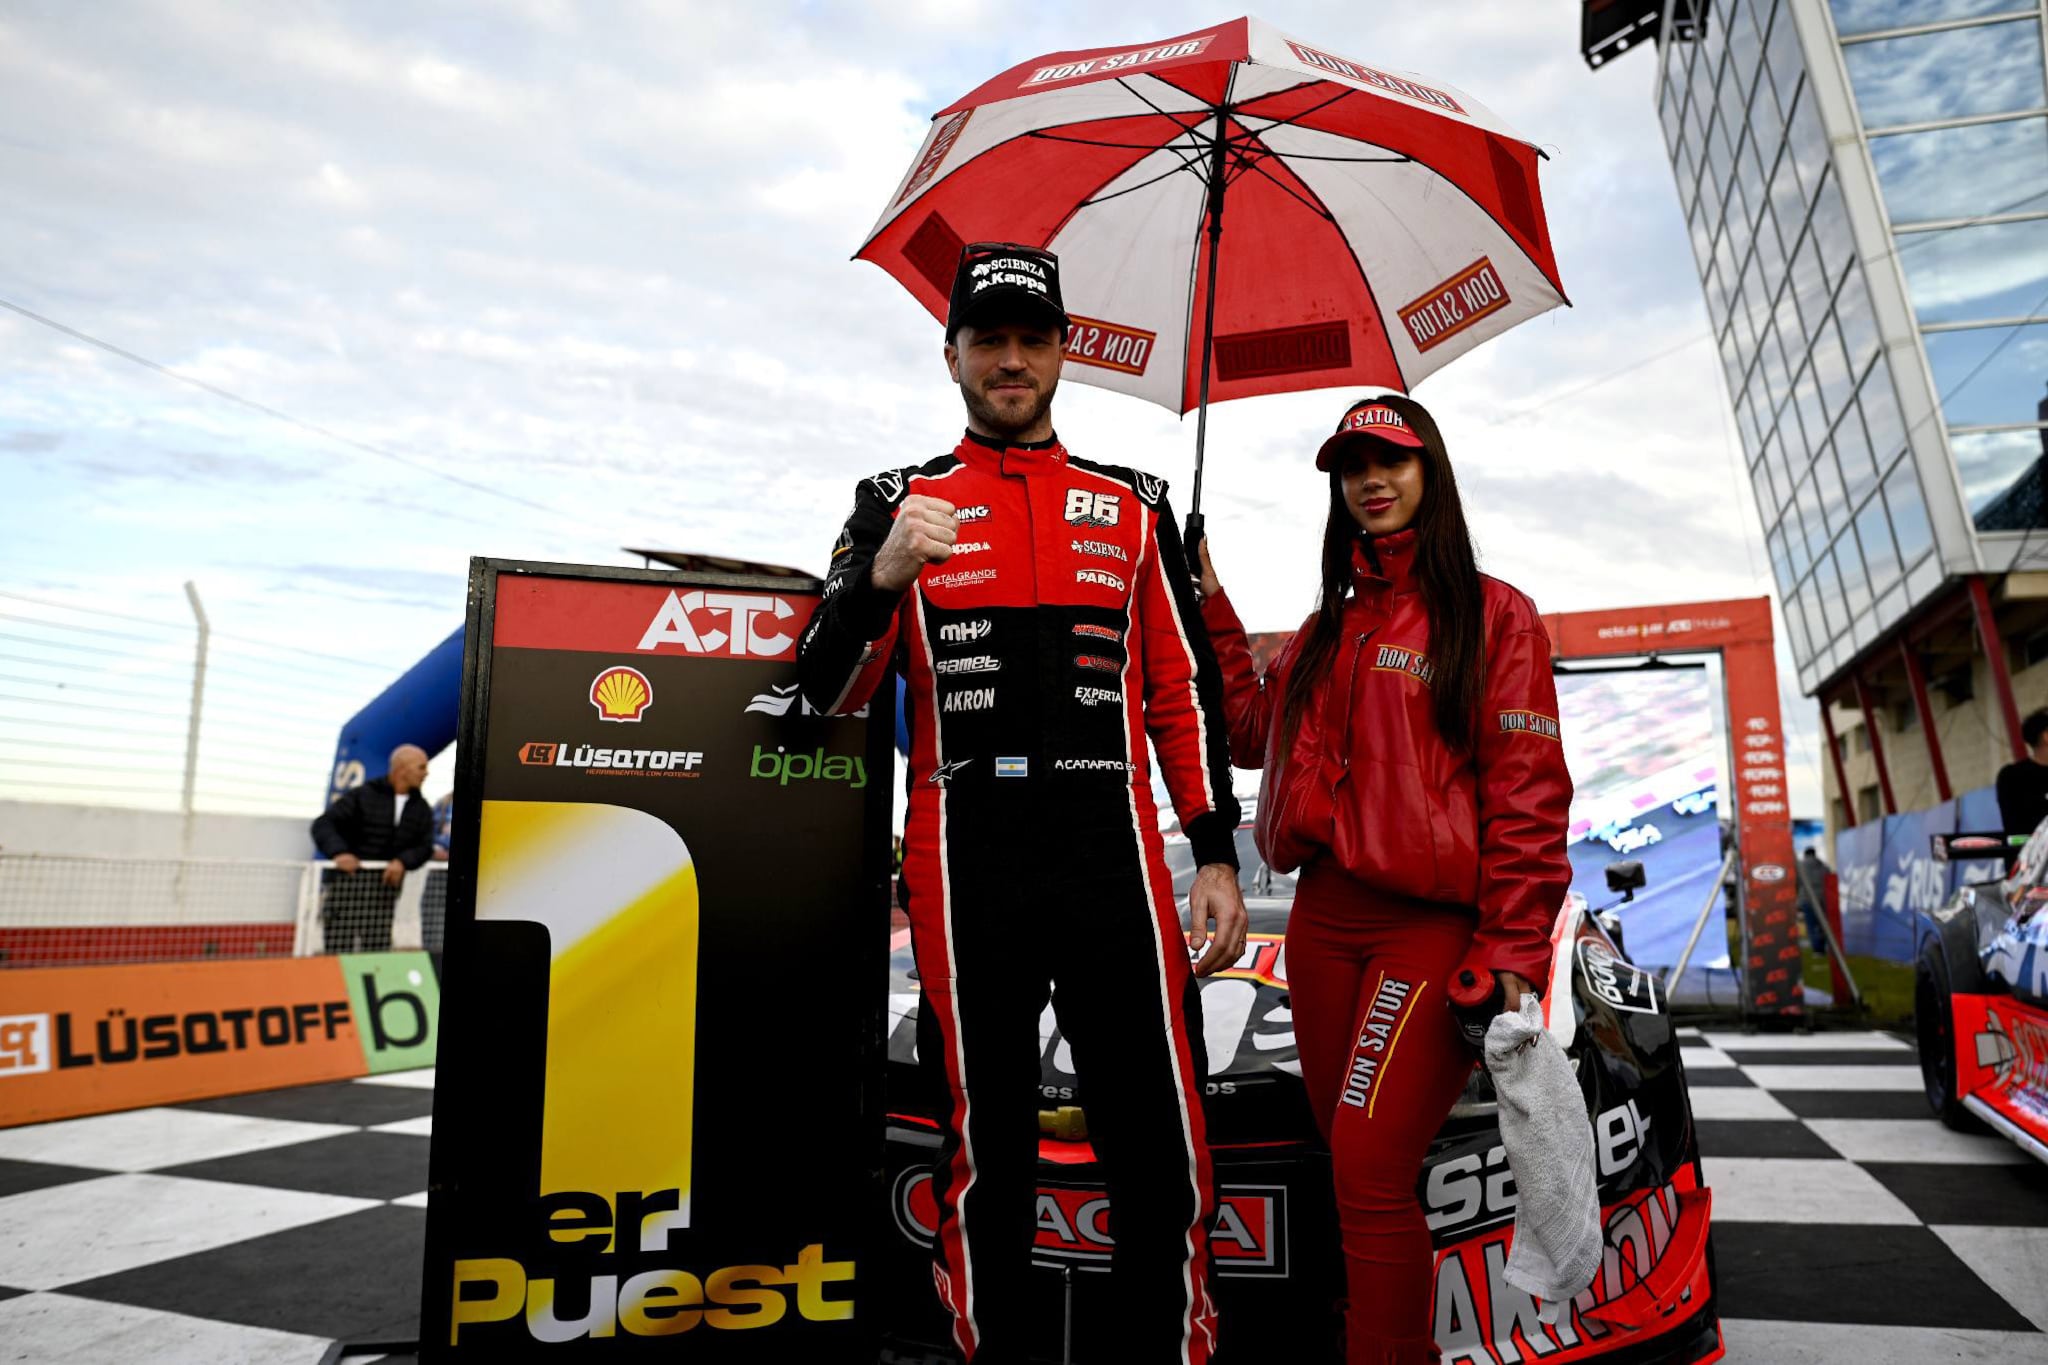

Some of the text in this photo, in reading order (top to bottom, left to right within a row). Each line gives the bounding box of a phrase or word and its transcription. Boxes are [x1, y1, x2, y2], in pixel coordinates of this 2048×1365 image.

[1031, 40, 1200, 83] DON SATUR
[1299, 47, 1458, 110] DON SATUR
[991, 258, 1046, 279] SCIENZA
[992, 271, 1047, 293] Kappa
[1064, 488, 1121, 525] 86
[1084, 540, 1128, 562] SCIENZA
[927, 569, 997, 585] METALGRANDE
[1076, 572, 1125, 592] PARDO
[636, 589, 795, 657] ACTC
[936, 655, 1000, 674] samet
[1376, 647, 1410, 669] DON
[943, 687, 995, 713] AKRON
[1075, 686, 1122, 703] EXPERTA
[1083, 698, 1099, 706] ART
[1500, 713, 1558, 738] DON SATUR
[555, 743, 703, 771] LÜSQTOFF
[56, 1001, 351, 1070] LÜSQTOFF
[1343, 978, 1410, 1108] DON SATUR
[1425, 1098, 1651, 1232] saet
